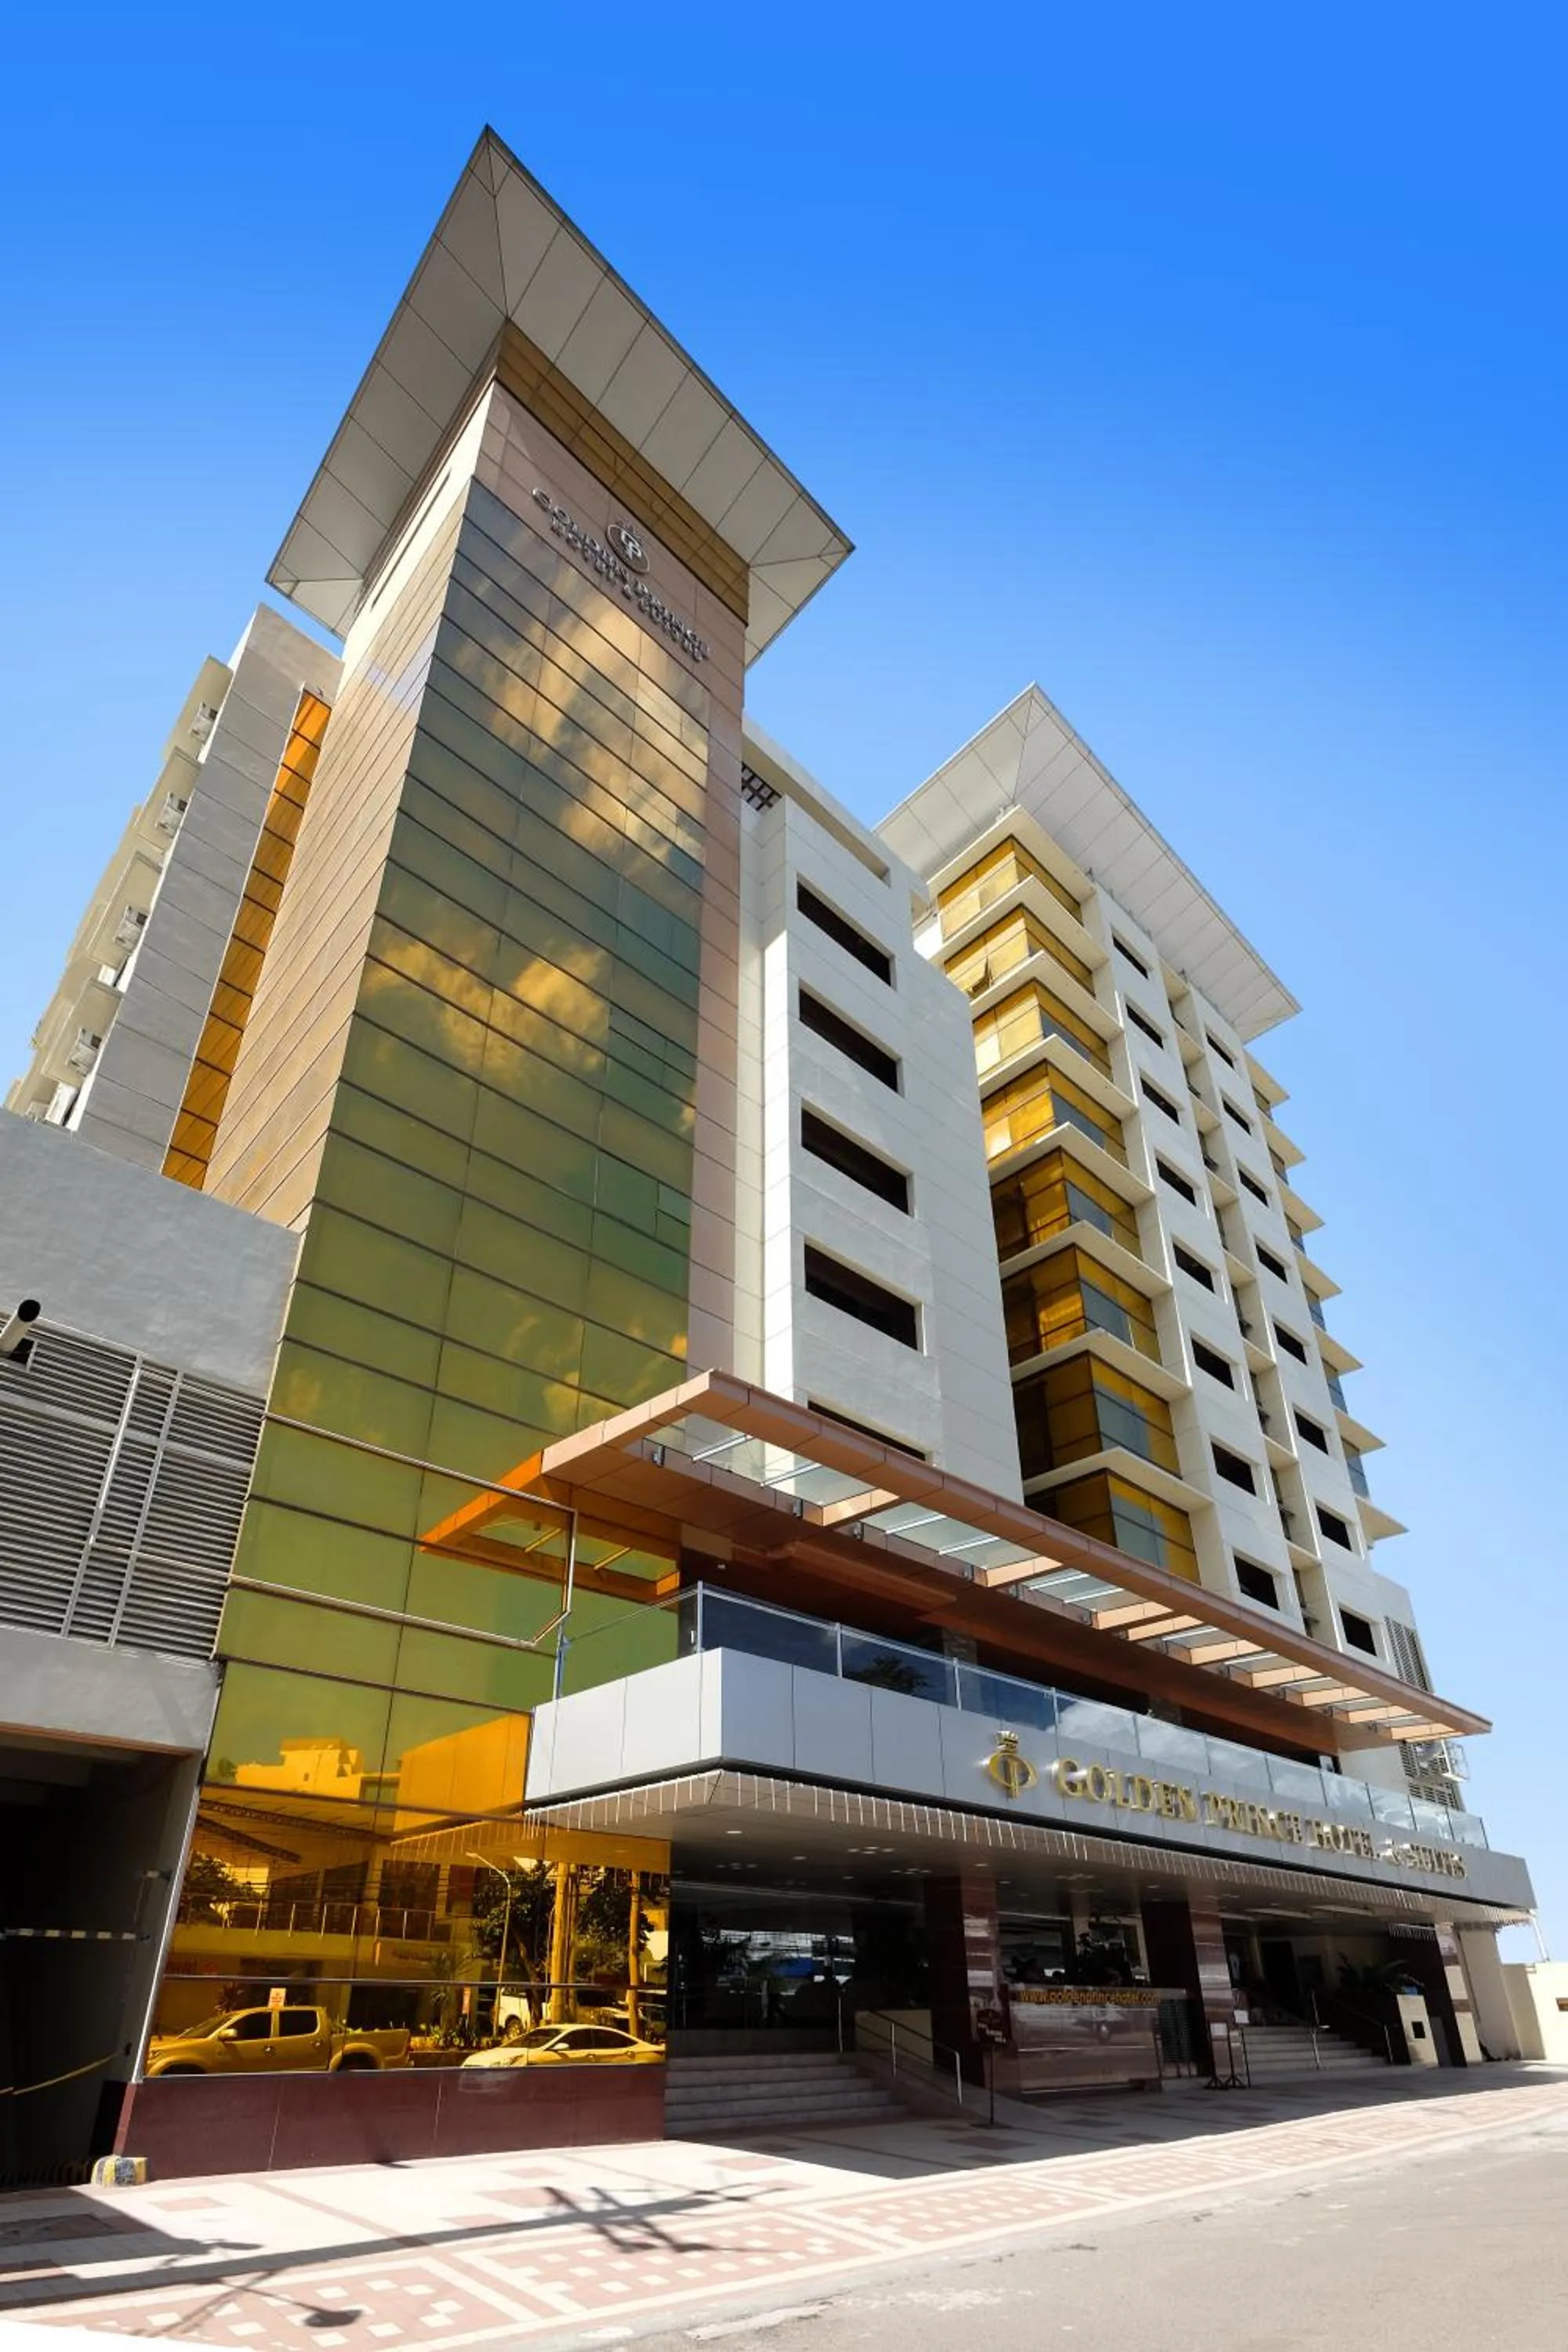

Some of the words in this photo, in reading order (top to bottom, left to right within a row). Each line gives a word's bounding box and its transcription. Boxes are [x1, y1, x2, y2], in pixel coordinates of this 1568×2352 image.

[1051, 1758, 1198, 1822] GOLDEN
[1203, 1792, 1304, 1842] PRINCE
[1307, 1819, 1379, 1860] HOTEL
[1404, 1843, 1466, 1878] SUITES
[1021, 1989, 1160, 2005] www.goldenprincehotel.com
